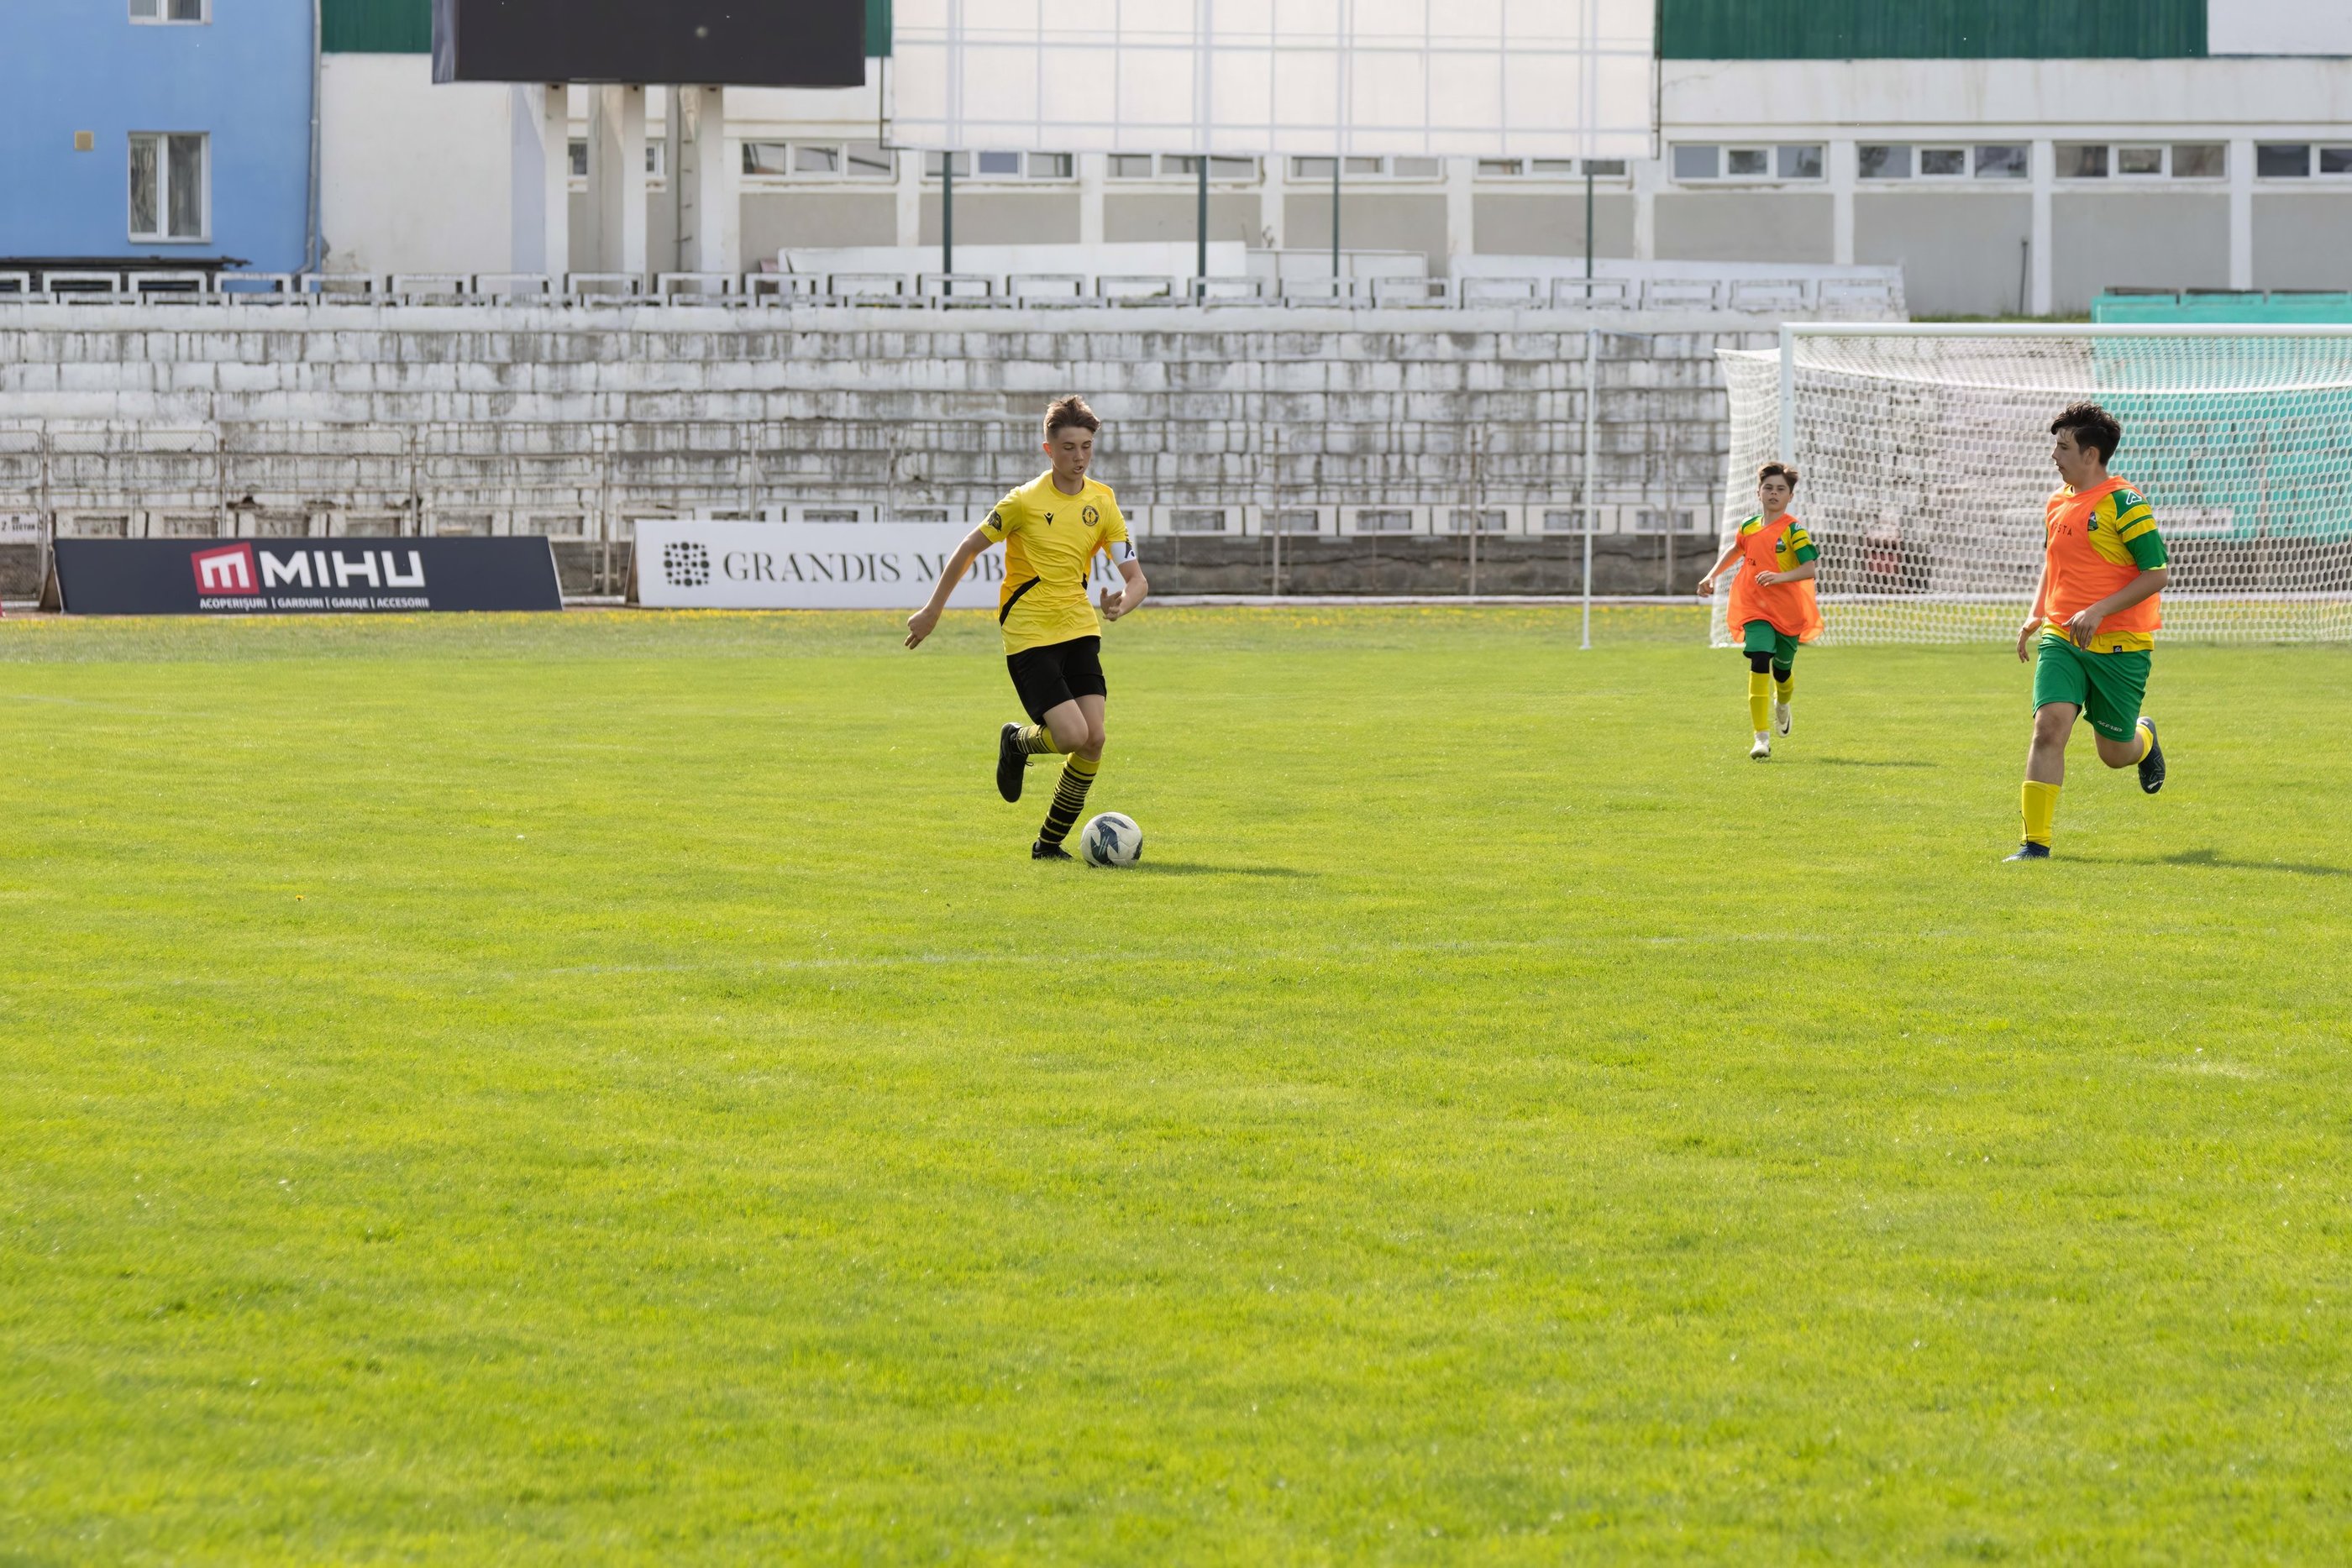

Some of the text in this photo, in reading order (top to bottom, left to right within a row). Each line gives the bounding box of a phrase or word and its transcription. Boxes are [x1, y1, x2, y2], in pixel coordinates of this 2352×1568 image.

[258, 551, 425, 588] MIHU
[723, 551, 900, 583] GRANDIS
[277, 597, 324, 610] GARDURI
[331, 597, 370, 610] GARAJE
[376, 597, 430, 609] ACCESORII
